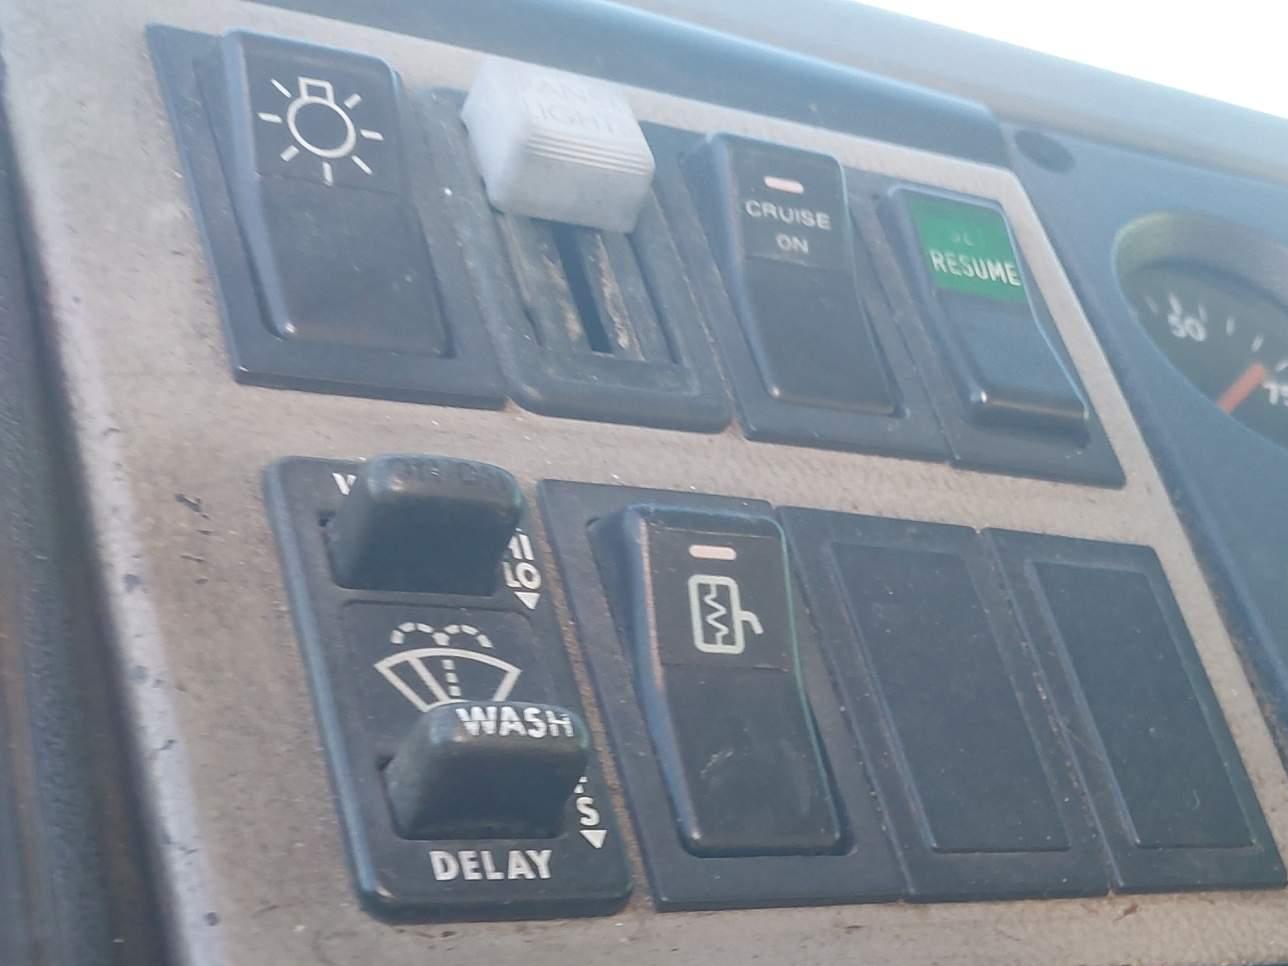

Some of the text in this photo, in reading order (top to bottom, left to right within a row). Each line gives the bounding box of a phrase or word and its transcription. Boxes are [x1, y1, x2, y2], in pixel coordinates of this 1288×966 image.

[745, 199, 831, 231] CRUISE
[776, 233, 809, 255] ON
[928, 248, 1021, 286] RESUME
[501, 561, 543, 592] LO
[457, 705, 575, 738] WASH
[575, 796, 601, 827] S
[431, 848, 553, 882] DELAY
